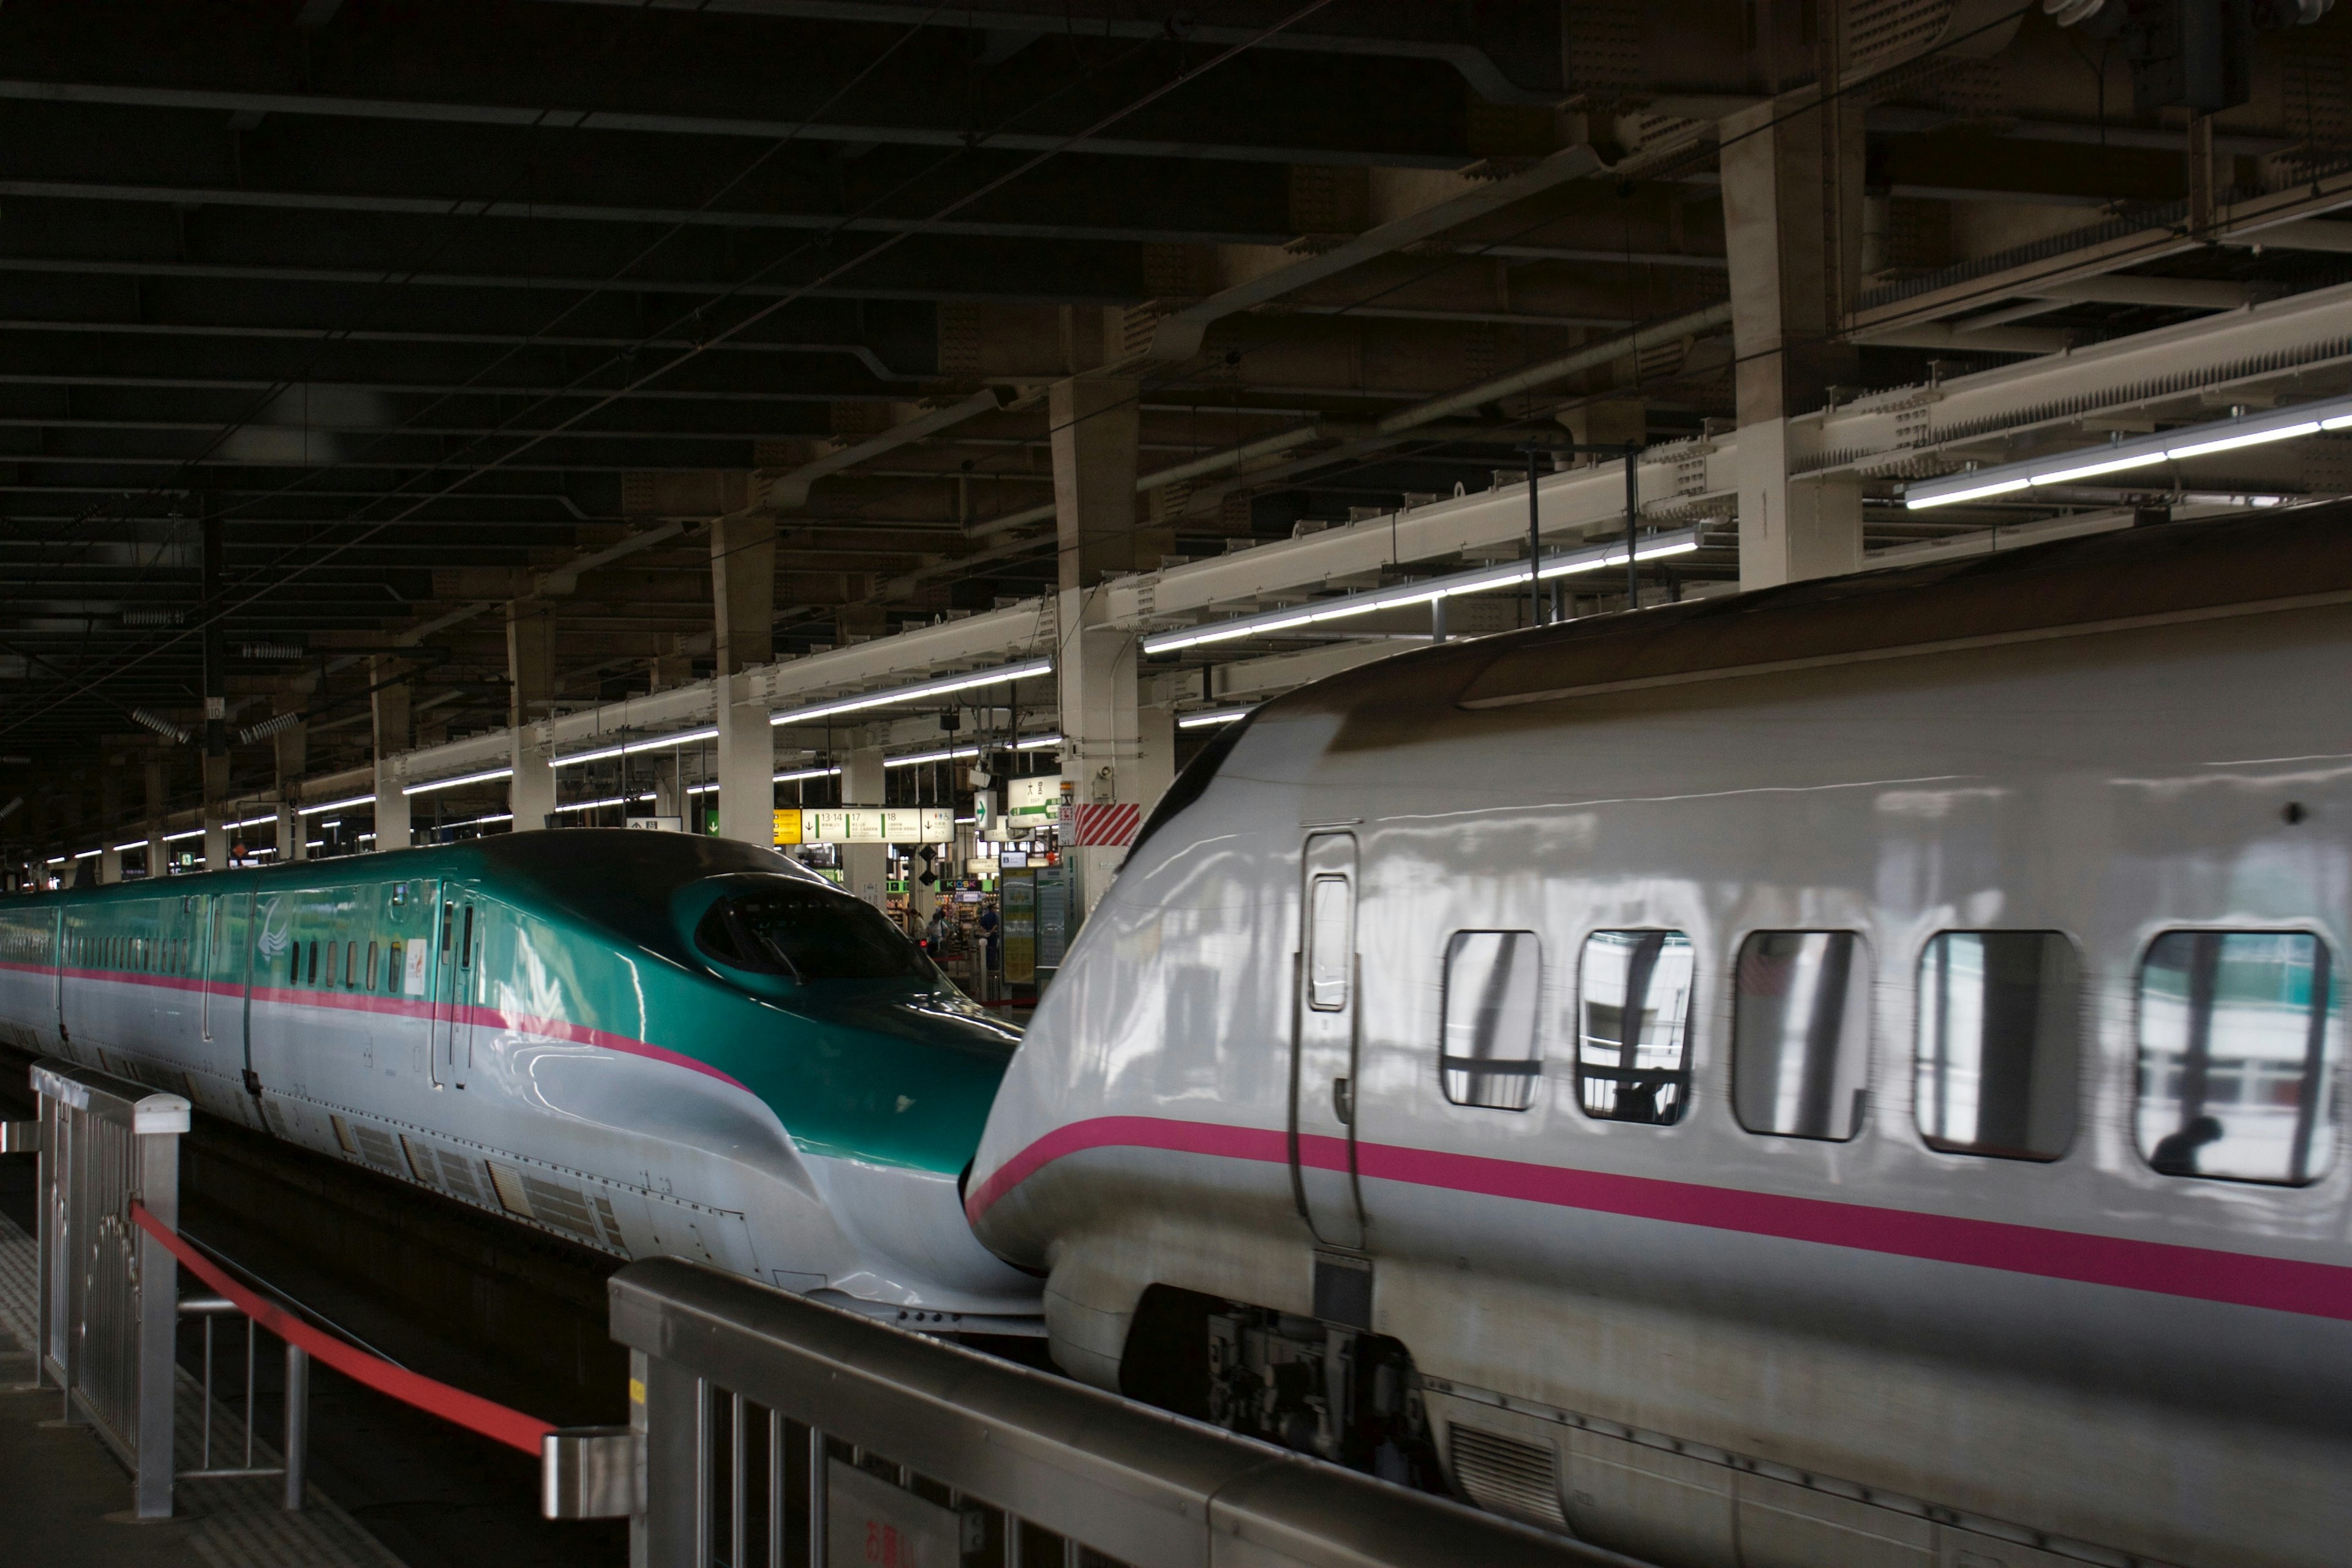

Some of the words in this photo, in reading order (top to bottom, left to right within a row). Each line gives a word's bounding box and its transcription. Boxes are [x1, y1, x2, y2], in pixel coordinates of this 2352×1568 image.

[1028, 782, 1043, 795] 大宮
[852, 813, 861, 821] 17
[888, 813, 896, 821] 18
